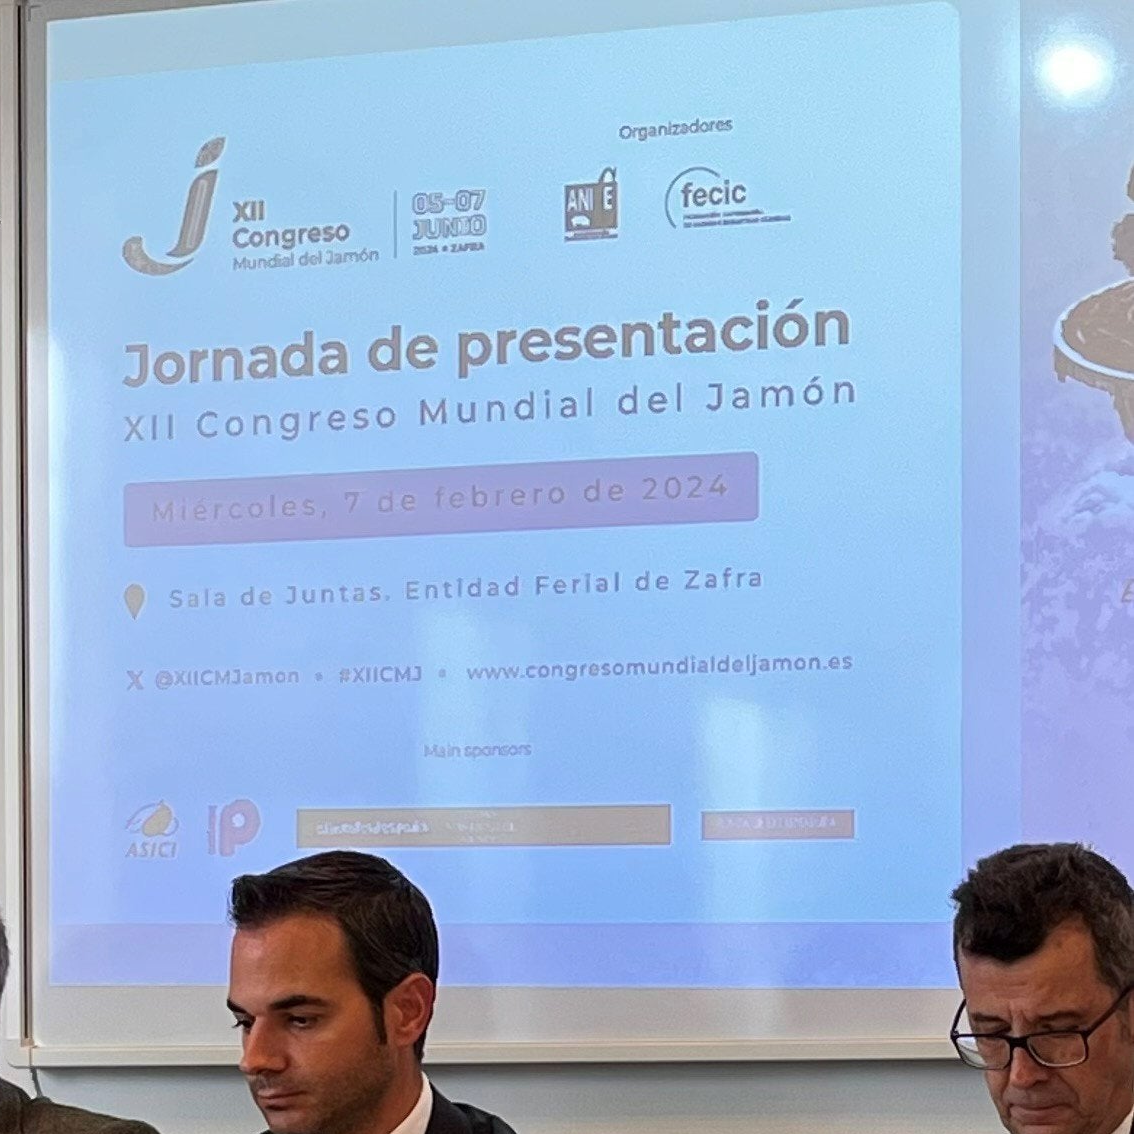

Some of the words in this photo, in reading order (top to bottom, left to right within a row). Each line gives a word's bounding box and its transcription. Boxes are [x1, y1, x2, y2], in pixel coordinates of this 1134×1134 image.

[618, 118, 733, 141] Organizadores
[681, 179, 748, 208] fecic
[233, 200, 265, 222] XII
[232, 222, 350, 250] Congreso
[232, 254, 294, 271] Mundial
[299, 250, 323, 266] del
[326, 248, 380, 267] Jamón
[122, 331, 349, 388] Jornada
[367, 324, 439, 371] de
[457, 298, 851, 379] presentación
[124, 414, 176, 443] XII
[196, 405, 397, 442] Congreso
[420, 388, 593, 426] Mundial
[618, 384, 682, 416] del
[706, 376, 856, 411] Jamón
[153, 491, 327, 523] Miércoles,
[344, 492, 360, 513] 7
[379, 487, 416, 513] de
[435, 482, 566, 510] febrero
[584, 479, 625, 503] de
[642, 474, 729, 501] 2024
[169, 588, 227, 609] Sala
[240, 587, 272, 608] de
[405, 576, 519, 601] Entidad
[535, 572, 621, 597] Ferial
[636, 571, 670, 593] de
[684, 567, 763, 591] Zafra
[339, 666, 422, 686] #XIICMJ
[466, 655, 853, 682] www.congresomundialdeljamon.es
[126, 842, 176, 858] ASICI
